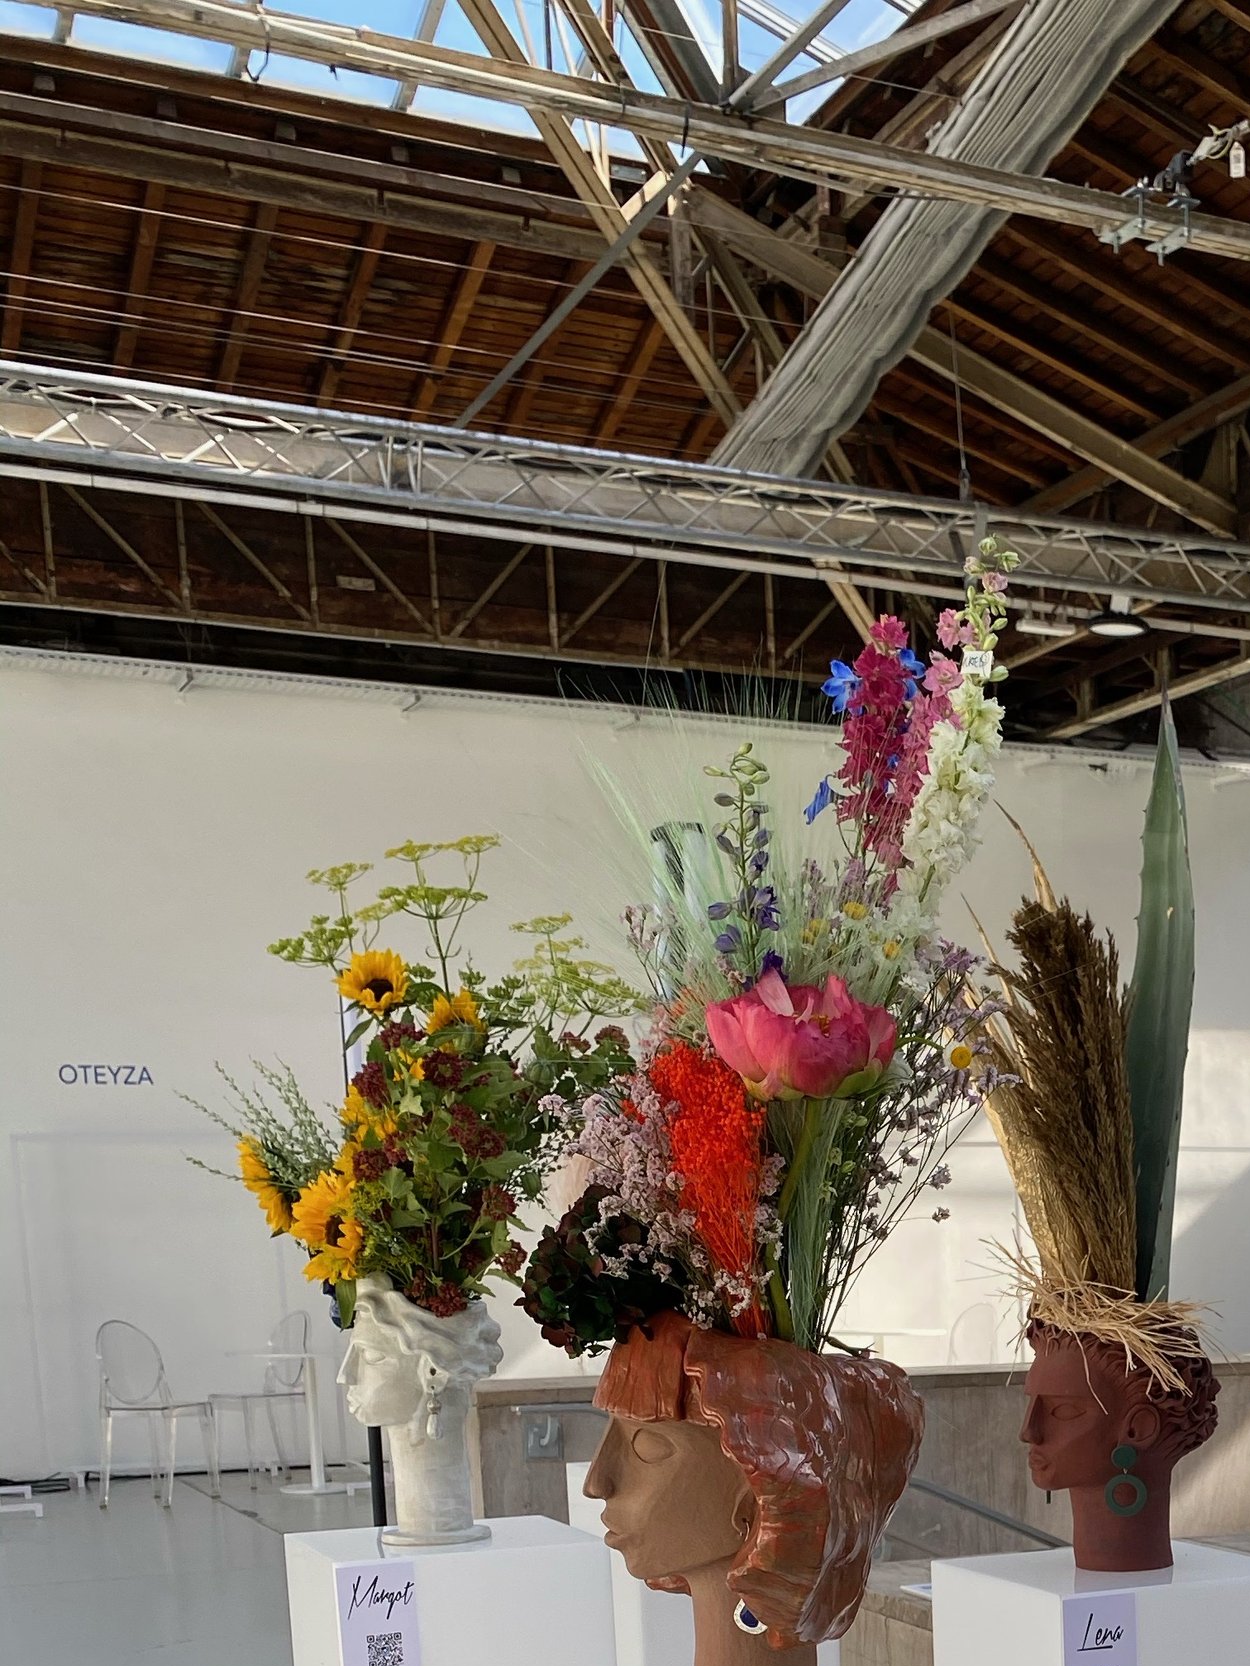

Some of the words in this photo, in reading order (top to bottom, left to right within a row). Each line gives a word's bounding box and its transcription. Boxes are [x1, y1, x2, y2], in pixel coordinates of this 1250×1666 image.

[58, 1064, 154, 1085] OTEYZA
[347, 1575, 414, 1620] Margot
[1077, 1613, 1124, 1651] Lena
